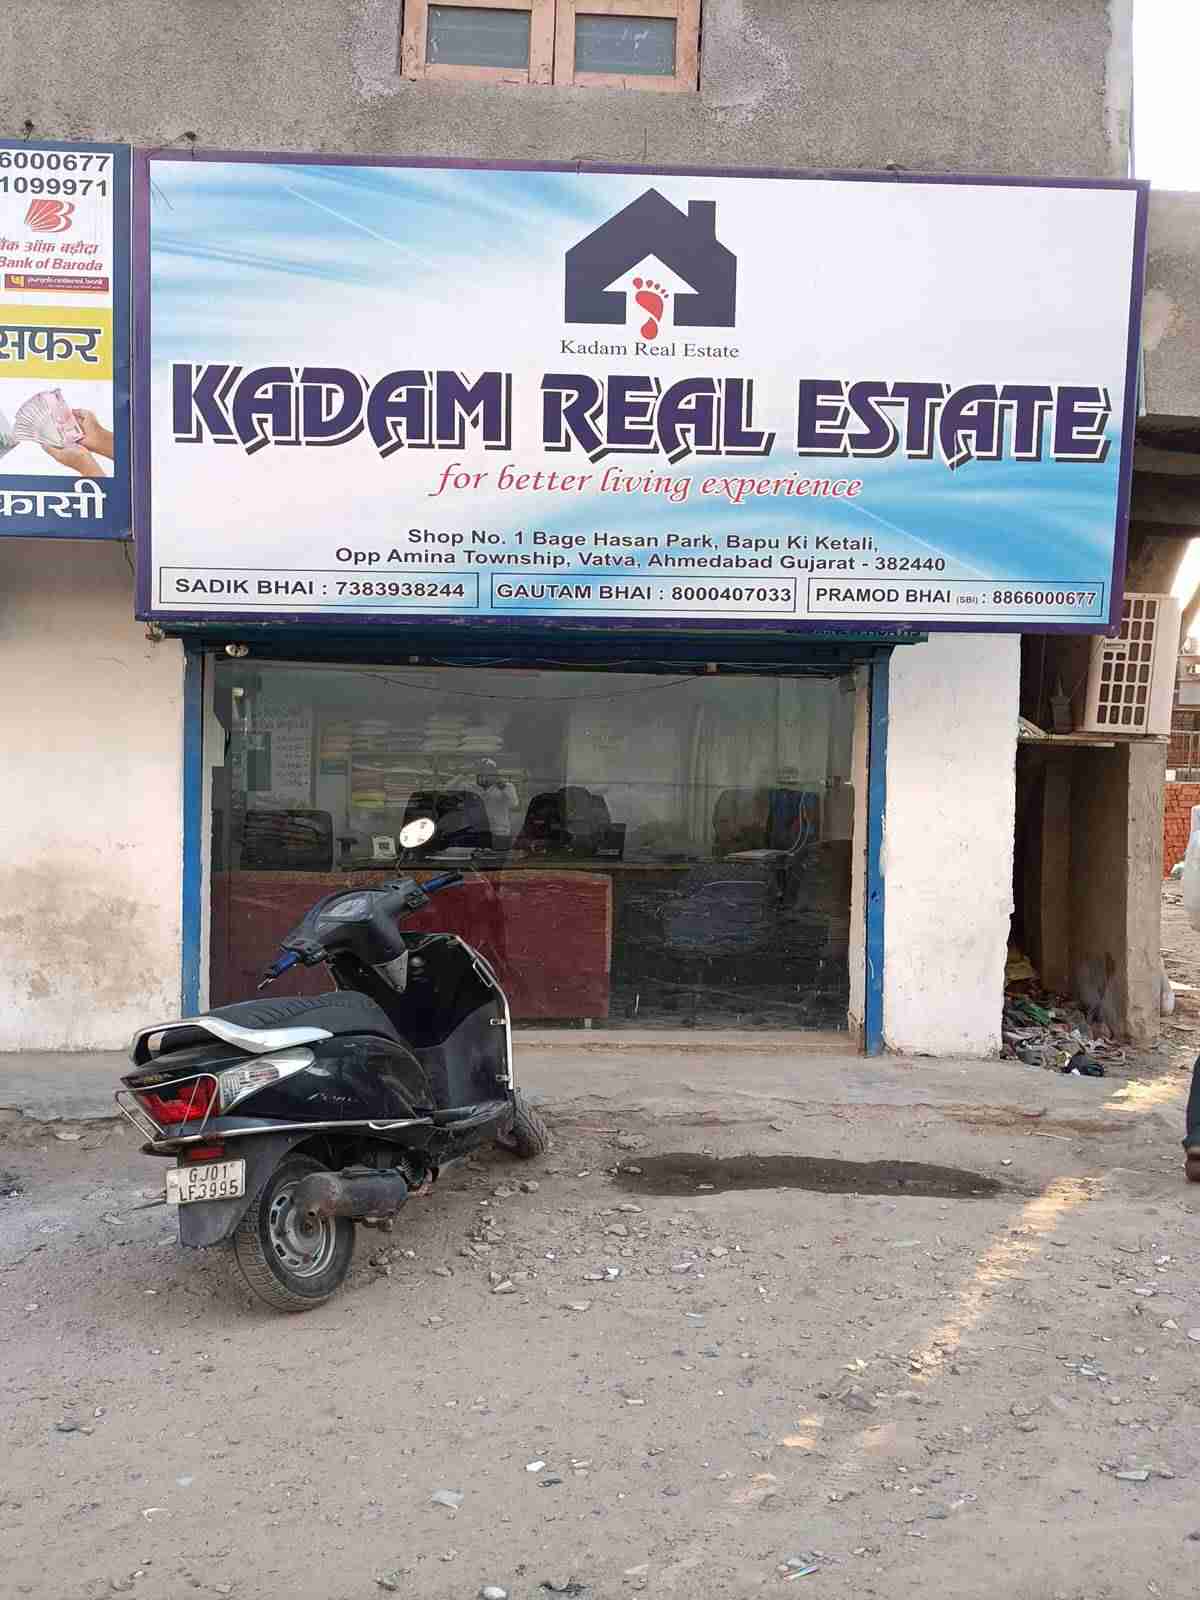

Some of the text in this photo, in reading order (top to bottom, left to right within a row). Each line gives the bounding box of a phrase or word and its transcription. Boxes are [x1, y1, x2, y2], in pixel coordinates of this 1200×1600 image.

[0, 152, 110, 172] 6000677
[0, 176, 108, 197] 1099971
[0, 256, 104, 271] Bank of Baroda
[560, 339, 740, 359] Kadam Real Estate
[172, 363, 1112, 471] KADAM REAL ESTATE
[428, 462, 863, 503] for better living experience
[408, 529, 878, 552] Shop No. 1 Bage Hasan Park, Bapu Ki Ketali,
[336, 547, 381, 564] Opp
[387, 548, 456, 564] Amina
[464, 550, 571, 567] Township,
[648, 553, 772, 570] Ahmedabad
[780, 555, 855, 572] Gujarat
[875, 557, 945, 571] 382440
[175, 578, 249, 594] SADIK
[257, 580, 314, 595] BHAI
[336, 581, 465, 597] 7383938244
[496, 584, 592, 600] GAUTAM
[599, 585, 652, 600] BHAI
[671, 586, 792, 602] 8000407033
[816, 587, 899, 603] PRAMOD
[906, 588, 951, 604] BHAI
[992, 590, 1097, 606] 8866000677
[189, 1165, 228, 1184] GJ01
